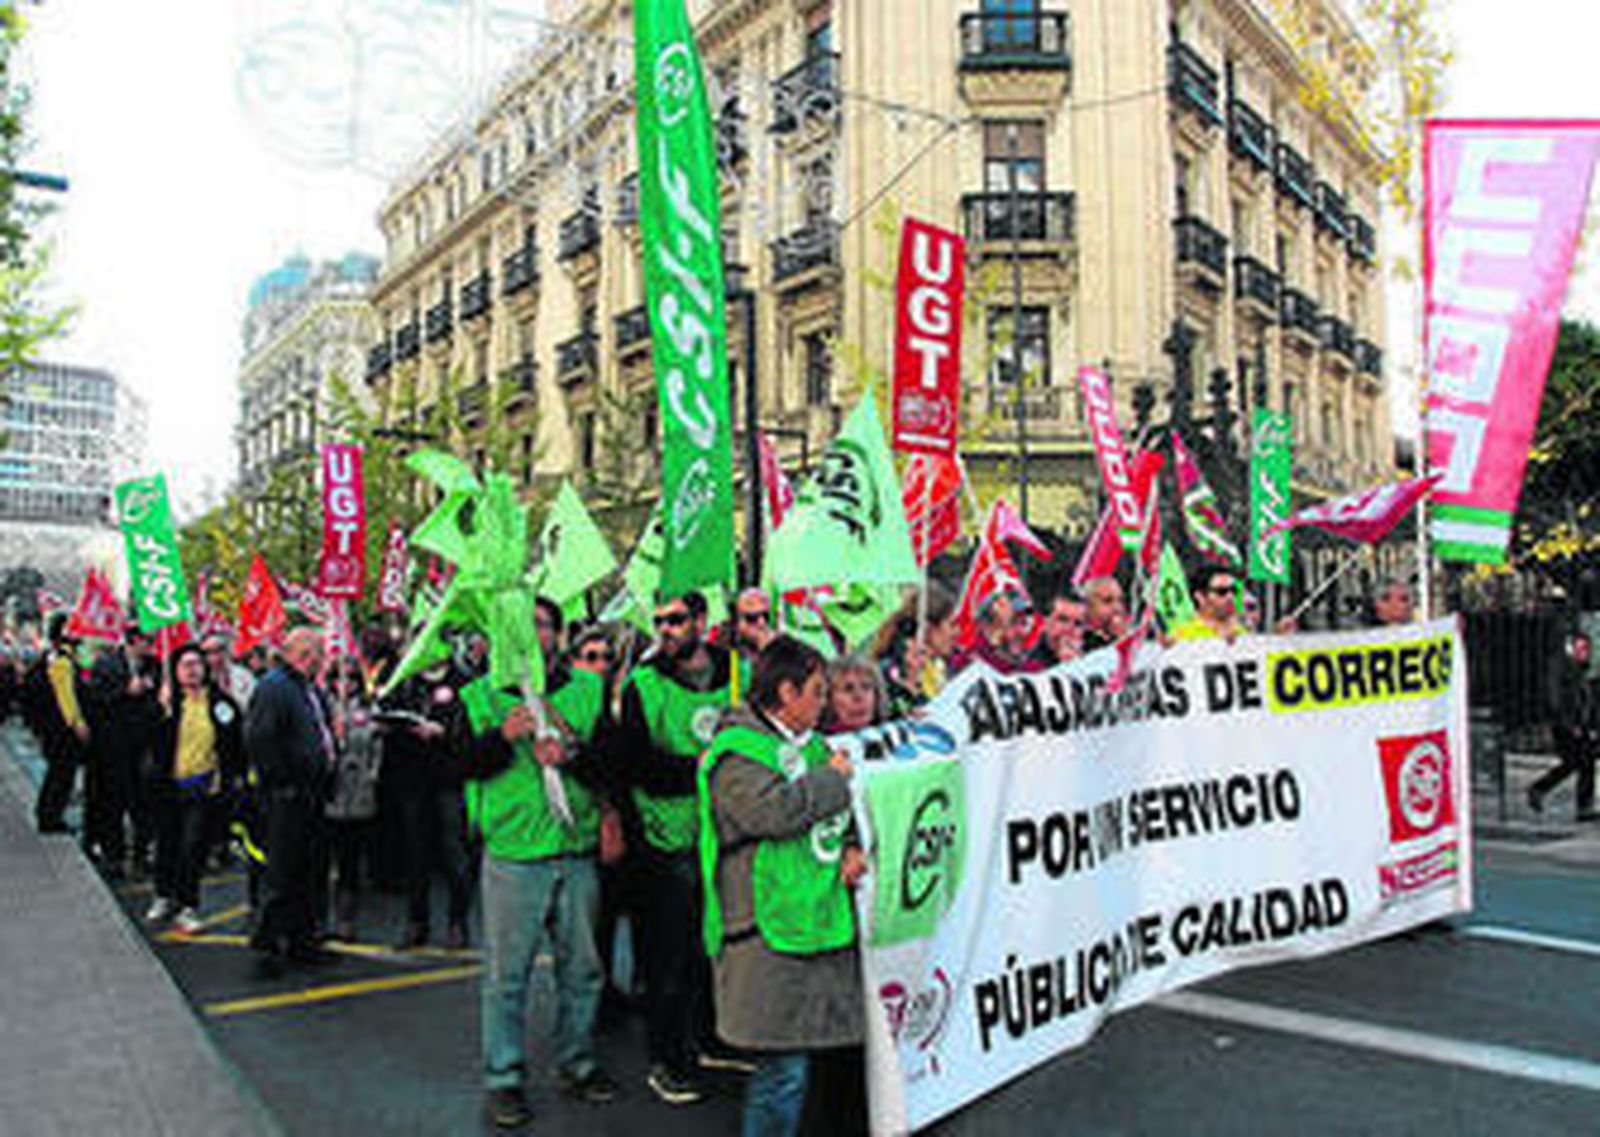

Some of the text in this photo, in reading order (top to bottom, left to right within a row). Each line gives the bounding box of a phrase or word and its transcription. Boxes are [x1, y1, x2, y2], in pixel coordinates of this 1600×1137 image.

[908, 230, 952, 388] UGT
[328, 451, 359, 554] UGT
[1204, 661, 1261, 713] DE
[1007, 811, 1096, 885] POR
[1128, 768, 1301, 848] SERVICIO
[1171, 878, 1349, 957] CALIDAD
